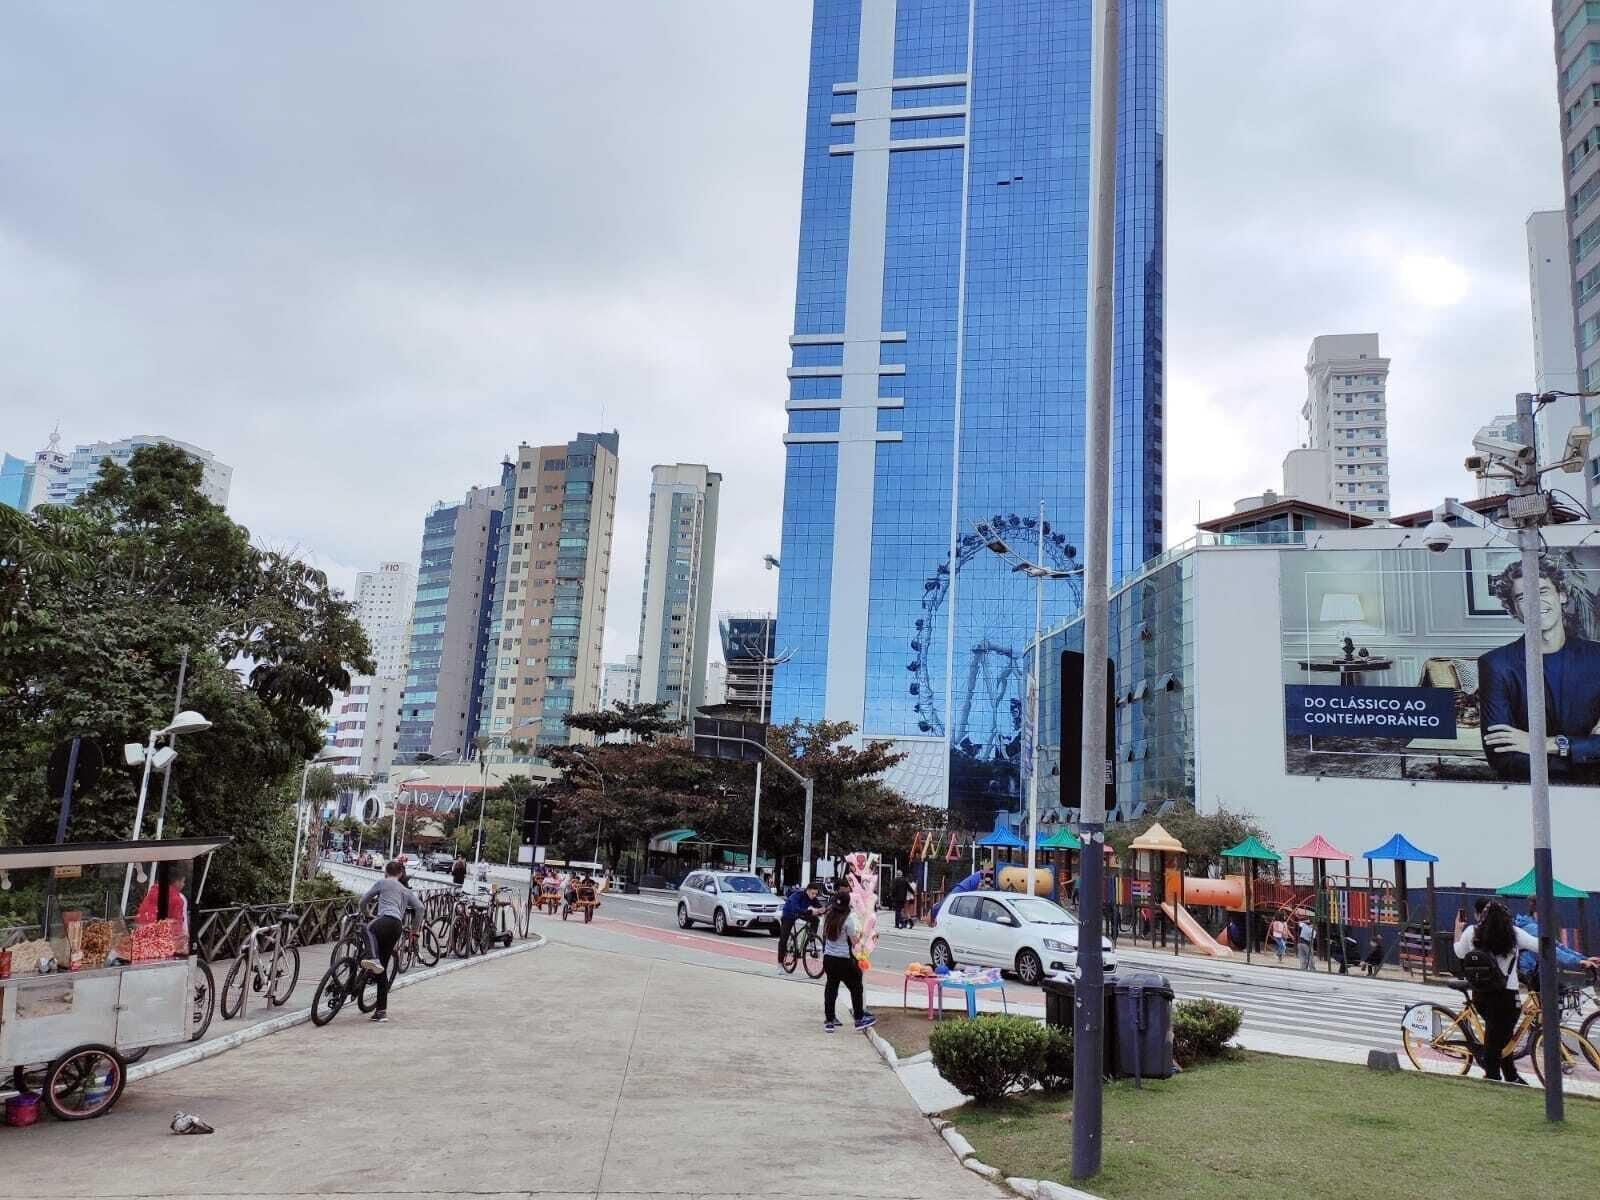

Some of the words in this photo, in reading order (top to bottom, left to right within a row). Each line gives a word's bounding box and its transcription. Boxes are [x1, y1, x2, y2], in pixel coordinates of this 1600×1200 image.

[1304, 697, 1326, 708] DO
[1329, 695, 1401, 710] CLÁSSICO
[1404, 700, 1426, 711] AO
[1304, 712, 1440, 726] CONTEMPORÂNEO
